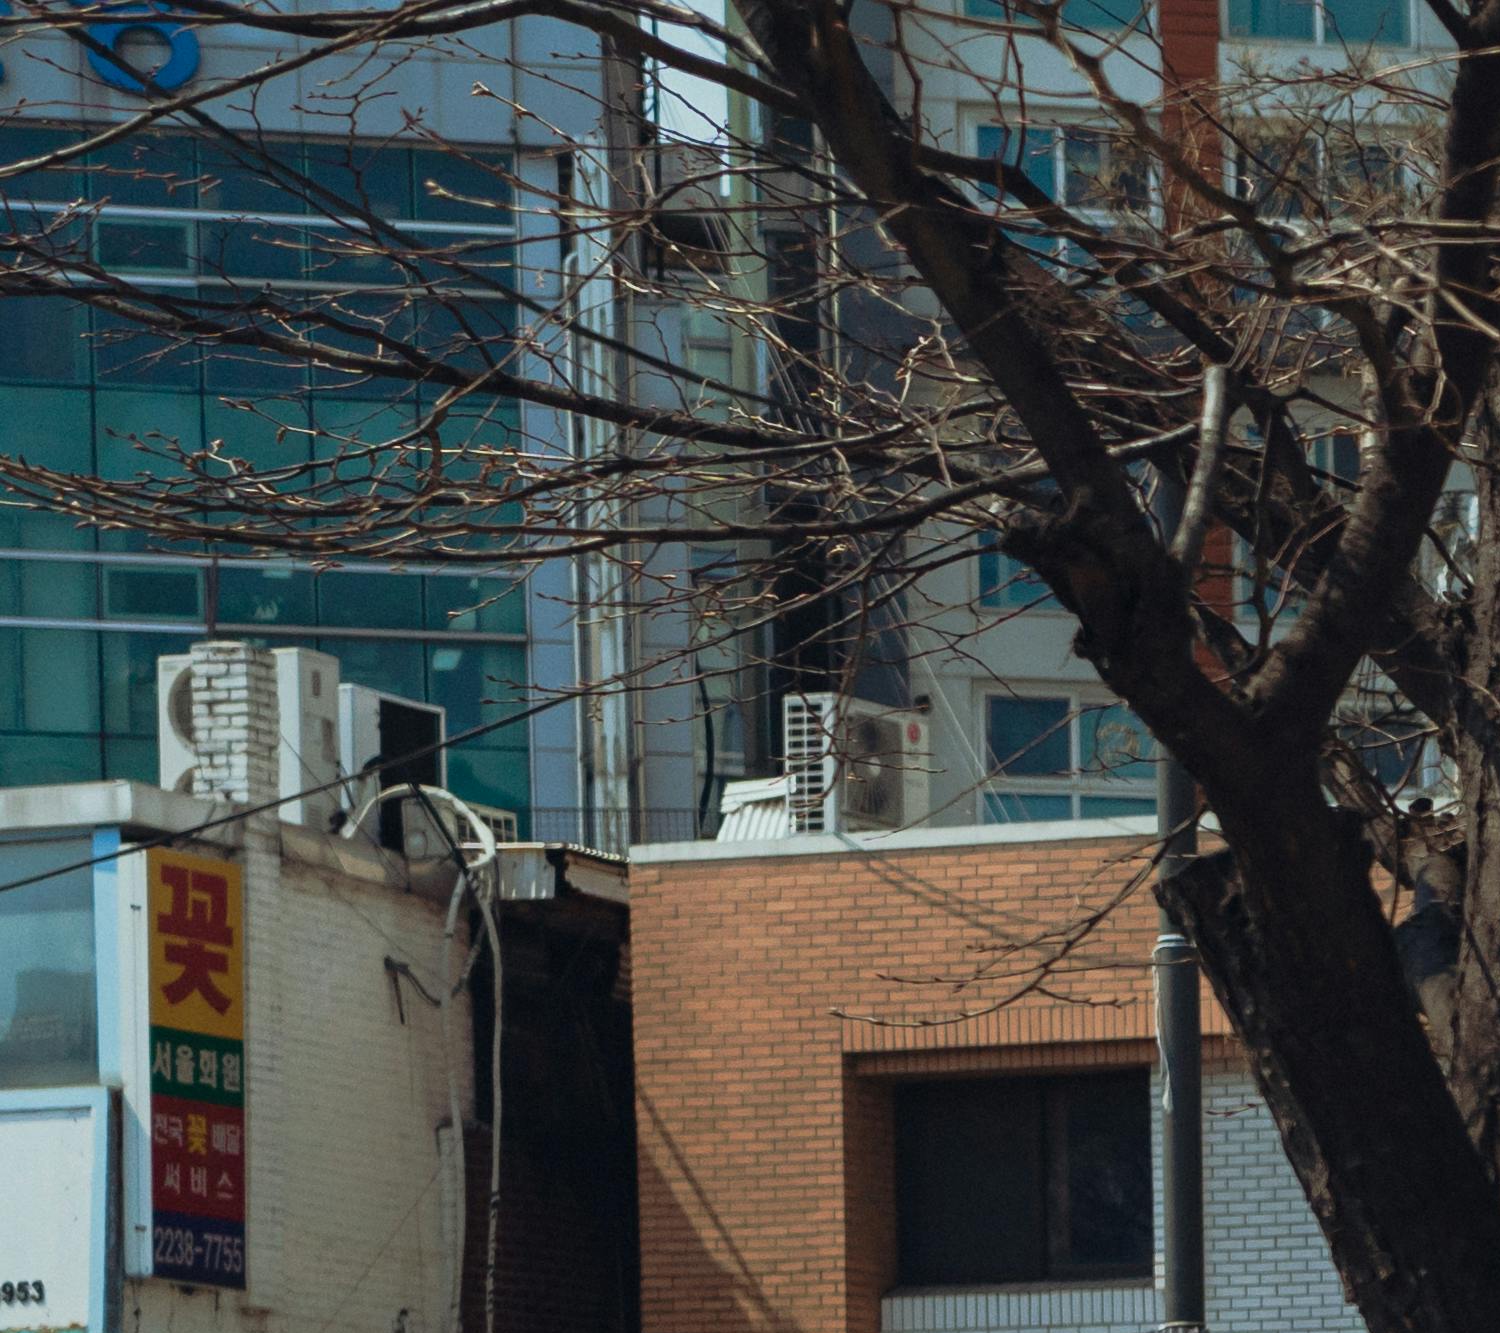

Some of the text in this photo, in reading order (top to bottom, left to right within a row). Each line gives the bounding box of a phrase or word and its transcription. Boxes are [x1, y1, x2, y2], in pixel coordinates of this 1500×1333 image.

[157, 866, 234, 1017] 꽃
[153, 1042, 241, 1093] 서울화원
[154, 1114, 184, 1145] 전국
[187, 1114, 207, 1155] 꽃
[164, 1164, 234, 1199] 써비스
[154, 1226, 242, 1275] 2238-7755
